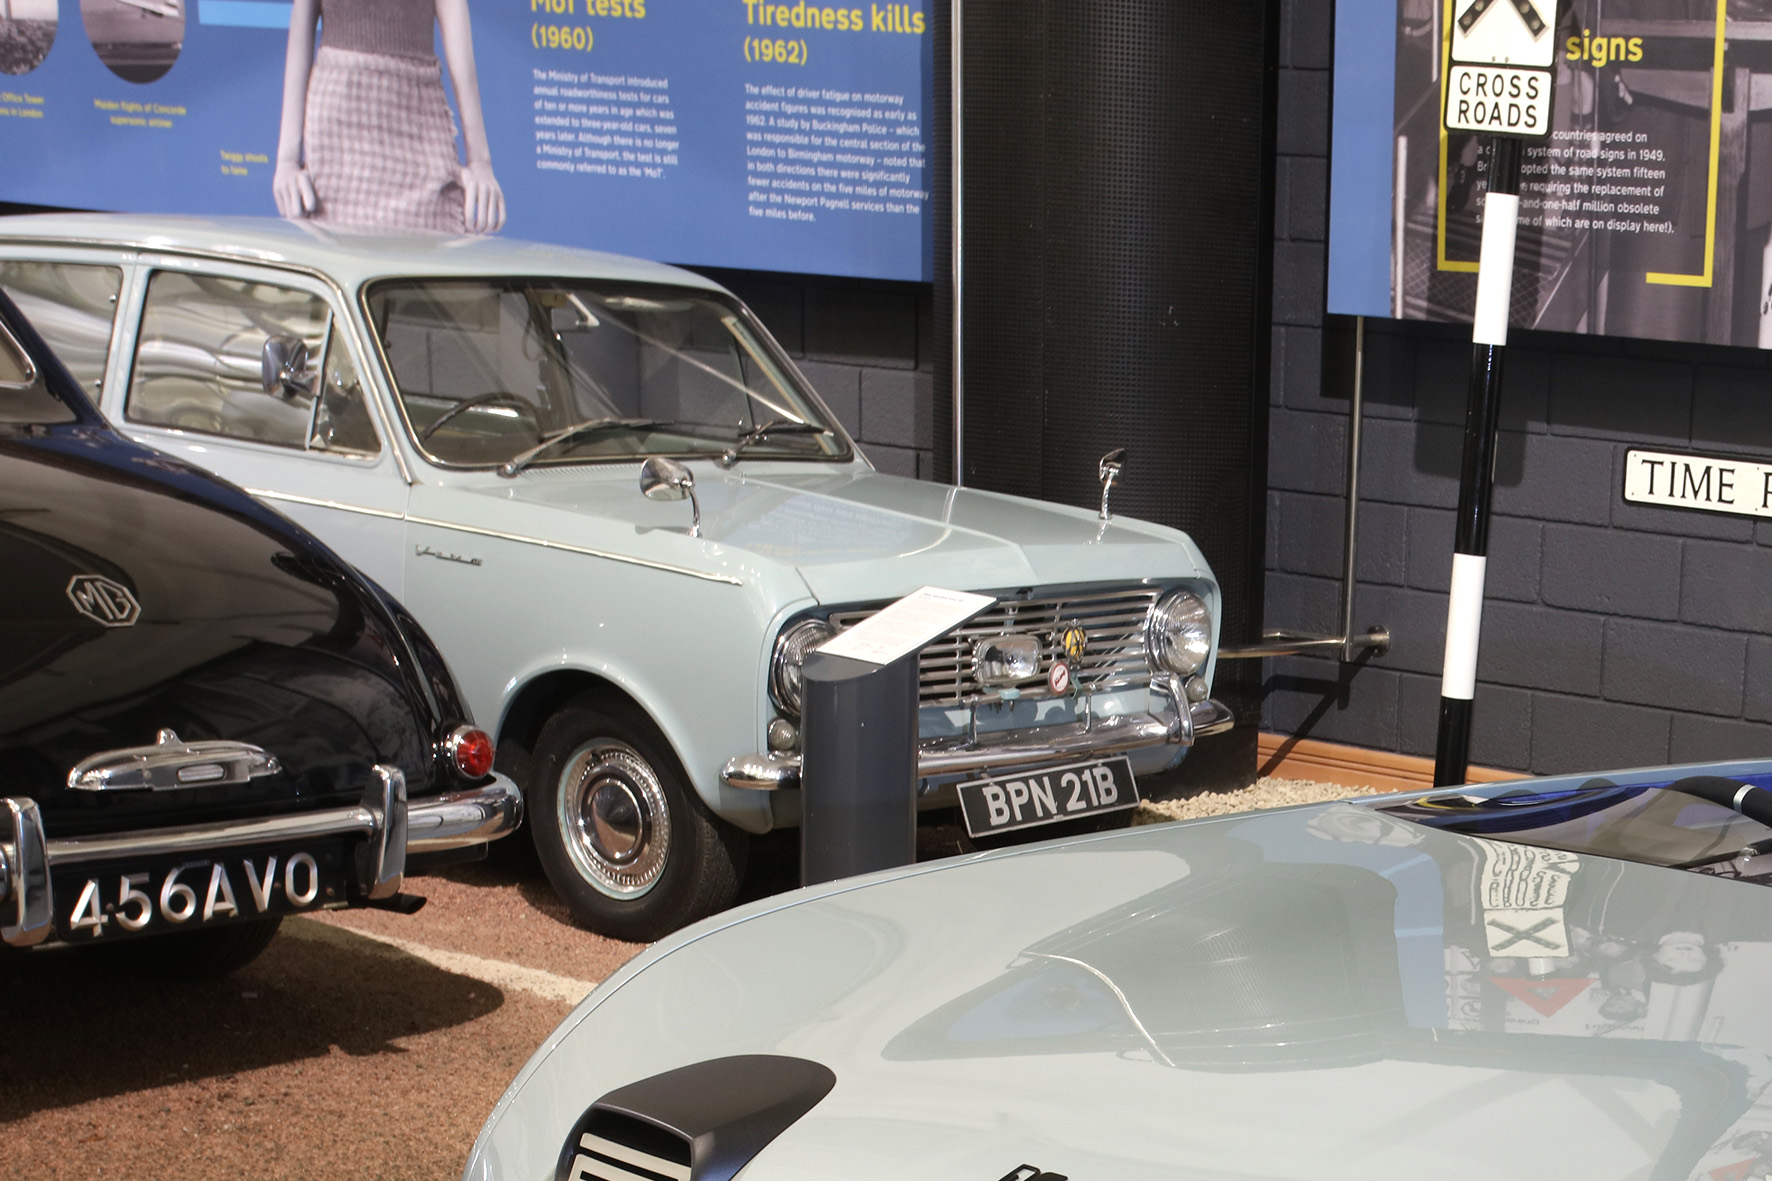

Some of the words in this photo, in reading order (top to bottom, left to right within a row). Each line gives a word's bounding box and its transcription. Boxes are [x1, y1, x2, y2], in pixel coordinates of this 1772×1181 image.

[586, 0, 646, 18] tests
[742, 0, 864, 31] Tiredness
[871, 3, 926, 34] kills
[531, 22, 594, 52] (1960)
[1566, 28, 1643, 67] signs
[744, 36, 808, 66] (1962)
[745, 83, 759, 94] The
[761, 85, 784, 96] effect
[787, 87, 795, 97] of
[797, 88, 819, 98] driver
[822, 89, 850, 101] fatigue
[852, 93, 862, 101] on
[864, 93, 903, 105] motorway
[1459, 72, 1539, 100] CROSS
[745, 101, 778, 111] accident
[781, 102, 808, 114] figures
[810, 106, 825, 114] was
[828, 107, 871, 118] recognised
[873, 110, 882, 118] as
[884, 110, 905, 121] early
[907, 111, 916, 120] as
[1458, 100, 1537, 128] ROADS
[746, 115, 765, 125] 1962.
[769, 116, 774, 125] A
[777, 118, 798, 129] study
[800, 119, 810, 130] by
[812, 120, 860, 132] Buckingham
[862, 123, 887, 134] Police
[896, 126, 919, 135] which
[1553, 129, 1597, 141] countries
[1599, 132, 1632, 143] agreed
[1634, 133, 1647, 142] on
[746, 132, 762, 140] was
[764, 133, 809, 144] responsible
[811, 134, 822, 145] for
[824, 136, 837, 146] the
[840, 139, 867, 148] central
[869, 140, 899, 150] section
[901, 141, 910, 151] of
[912, 141, 925, 152] the
[747, 146, 775, 156] London
[777, 148, 786, 158] to
[788, 148, 834, 161] Birmingham
[836, 154, 874, 166] motorway
[884, 157, 907, 166] noted
[908, 157, 925, 168] that
[1477, 146, 1483, 154] a
[1527, 146, 1561, 159] system
[1562, 147, 1574, 158] of
[1575, 148, 1599, 159] road
[1600, 149, 1624, 162] signs
[1627, 148, 1636, 159] in
[1639, 149, 1665, 161] 1949.
[748, 161, 754, 170] in
[756, 162, 774, 171] both
[776, 164, 815, 175] directions
[817, 166, 838, 177] there
[840, 170, 859, 179] were
[862, 171, 910, 183] significantly
[1550, 163, 1566, 175] the
[1569, 165, 1593, 176] same
[1597, 166, 1630, 180] system
[1633, 166, 1665, 179] fifteen
[748, 176, 769, 186] fewer
[772, 179, 809, 190] accidents
[812, 182, 822, 191] on
[824, 182, 836, 192] the
[838, 183, 853, 193] five
[855, 185, 877, 195] miles
[878, 186, 887, 196] of
[889, 188, 928, 199] motorway
[1530, 181, 1571, 196] requiring
[1574, 182, 1589, 193] the
[1592, 182, 1651, 196] replacement
[1654, 185, 1664, 197] of
[748, 191, 767, 201] after
[769, 192, 782, 203] the
[784, 194, 818, 206] Newport
[820, 197, 849, 209] Pagnell
[851, 201, 884, 211] services
[886, 202, 904, 212] than
[906, 204, 920, 214] the
[749, 206, 763, 216] five
[765, 208, 786, 218] miles
[788, 210, 815, 221] before.
[1582, 200, 1614, 212] million
[1617, 202, 1659, 214] obsolete
[1534, 214, 1543, 226] of
[1545, 213, 1572, 228] which
[1575, 219, 1589, 228] are
[1593, 220, 1604, 229] on
[1607, 218, 1641, 233] display
[1643, 220, 1674, 233] here!).
[1641, 459, 1736, 504] TIME
[75, 579, 132, 621] MG
[982, 776, 1058, 826] BPN
[1061, 766, 1118, 812] 21B
